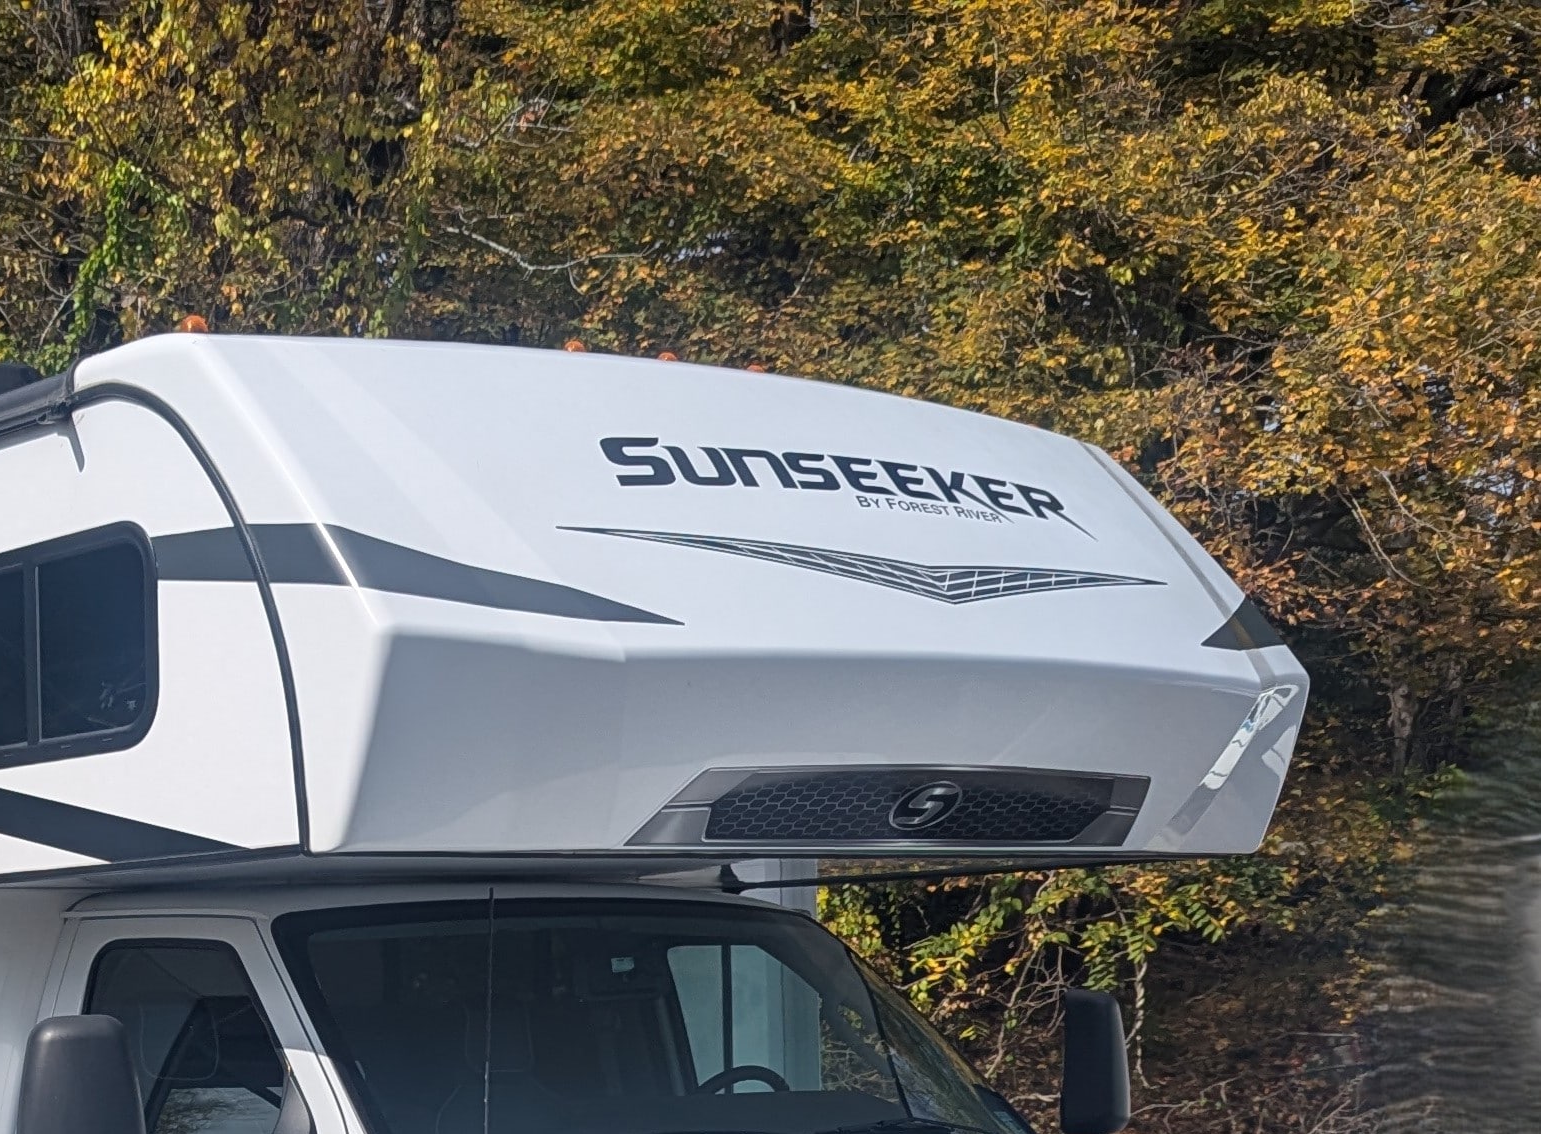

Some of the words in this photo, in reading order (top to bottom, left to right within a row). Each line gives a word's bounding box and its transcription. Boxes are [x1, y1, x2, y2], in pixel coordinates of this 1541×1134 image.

[599, 436, 1097, 541] SUNSEEKER
[885, 497, 951, 516] FOREST
[953, 505, 1003, 524] RIVER
